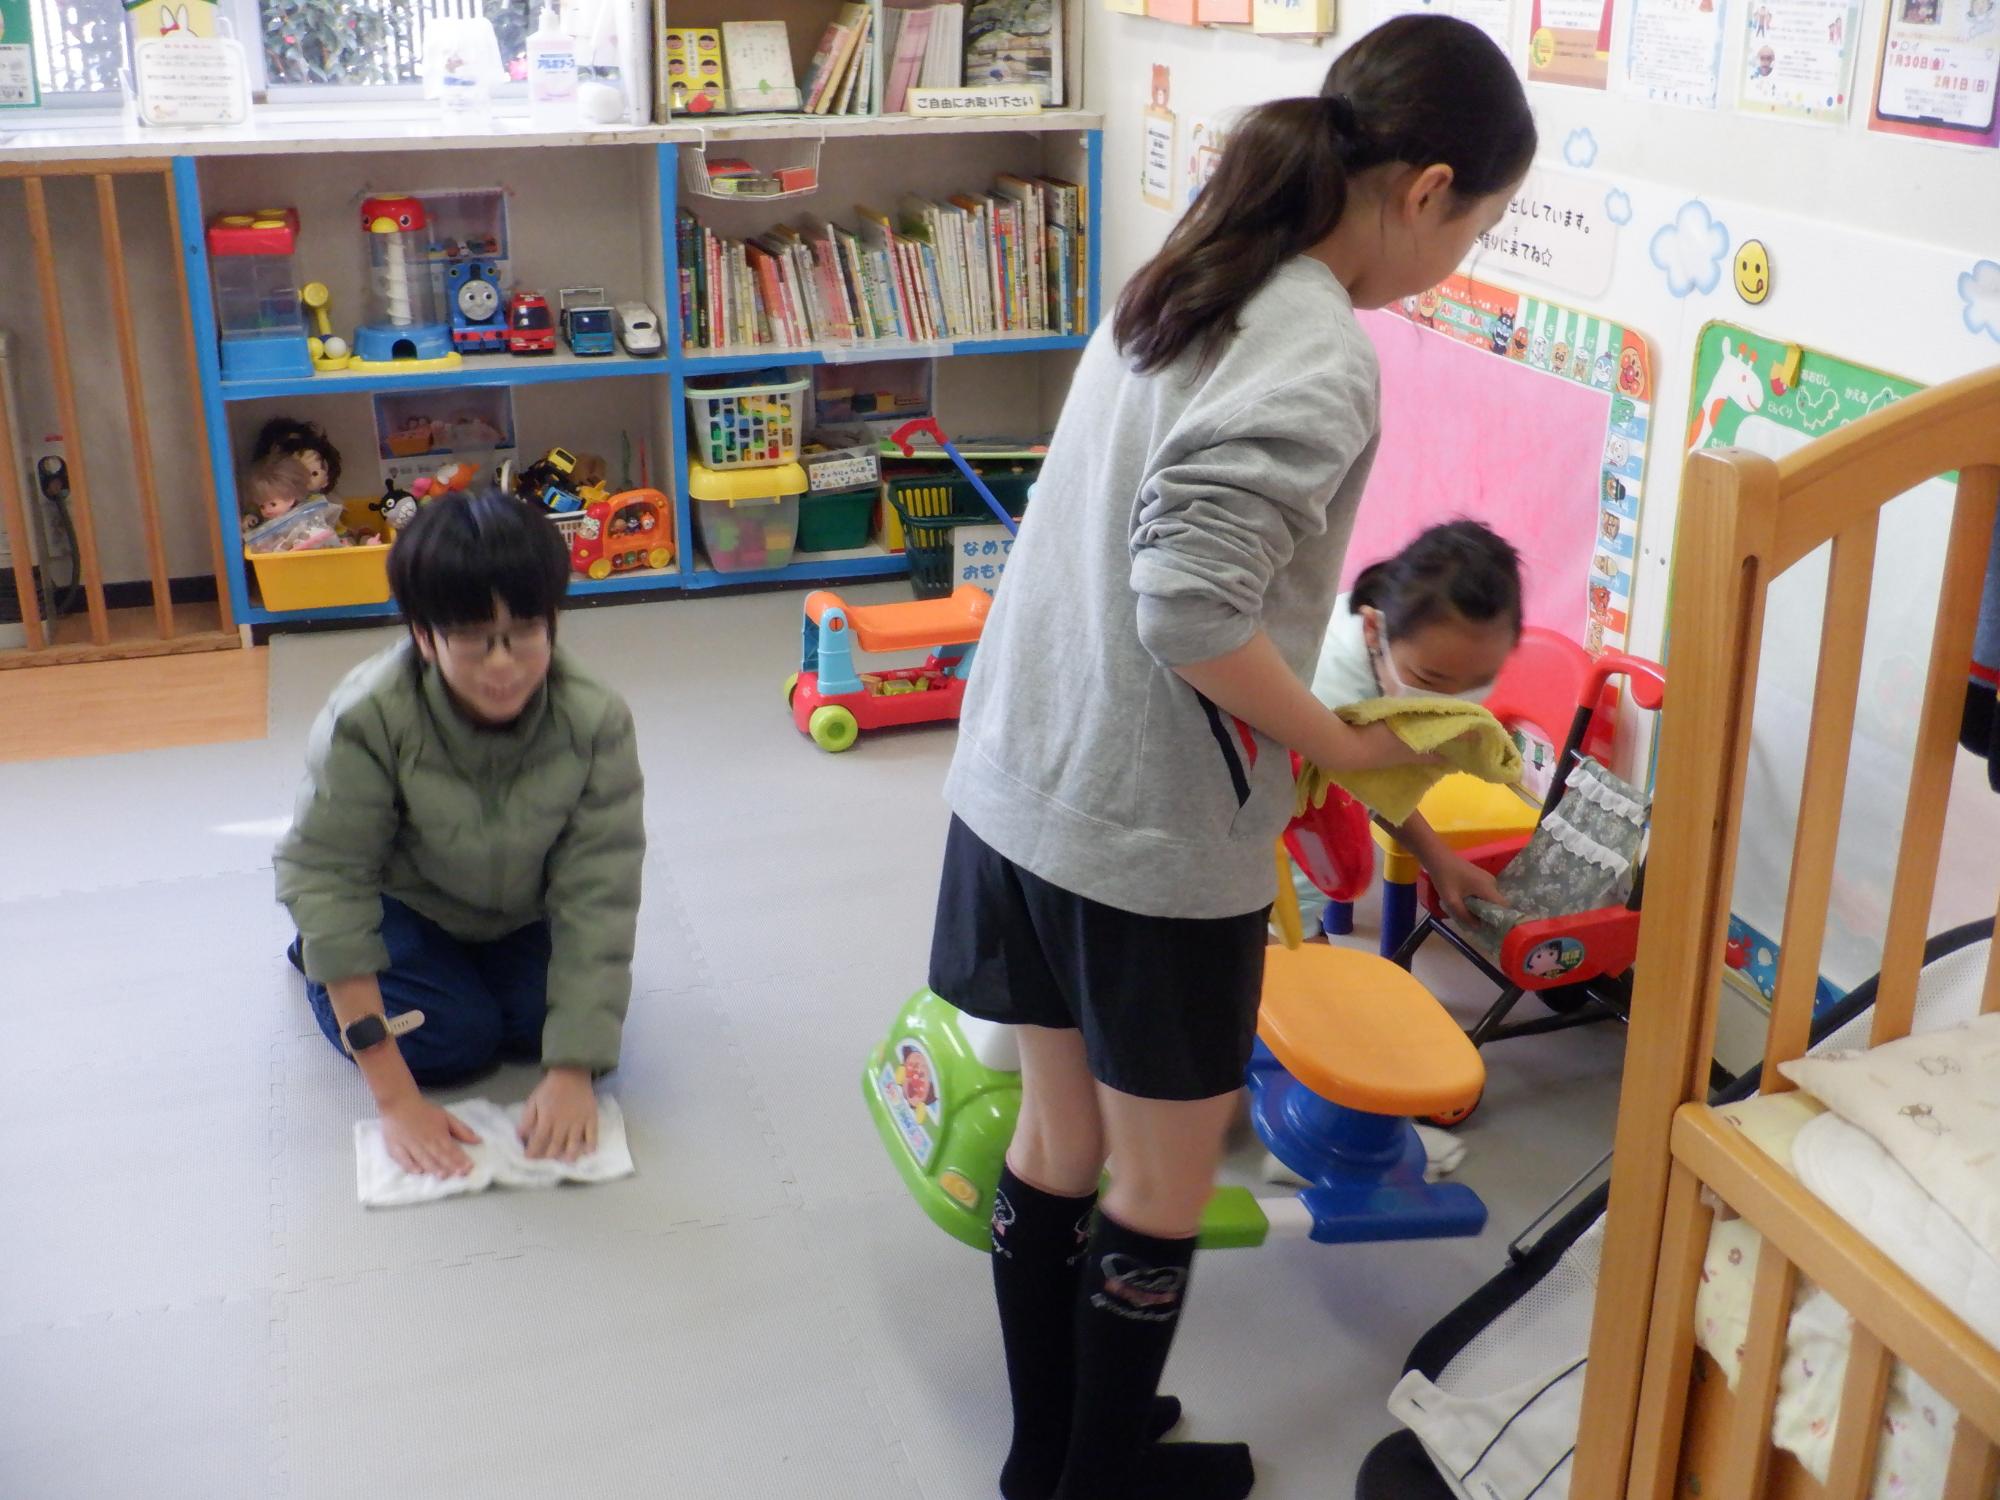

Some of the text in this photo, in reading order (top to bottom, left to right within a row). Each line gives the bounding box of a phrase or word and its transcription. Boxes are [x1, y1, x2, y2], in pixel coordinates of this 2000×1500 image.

[917, 96, 1034, 109] ご自由にお取り下さい
